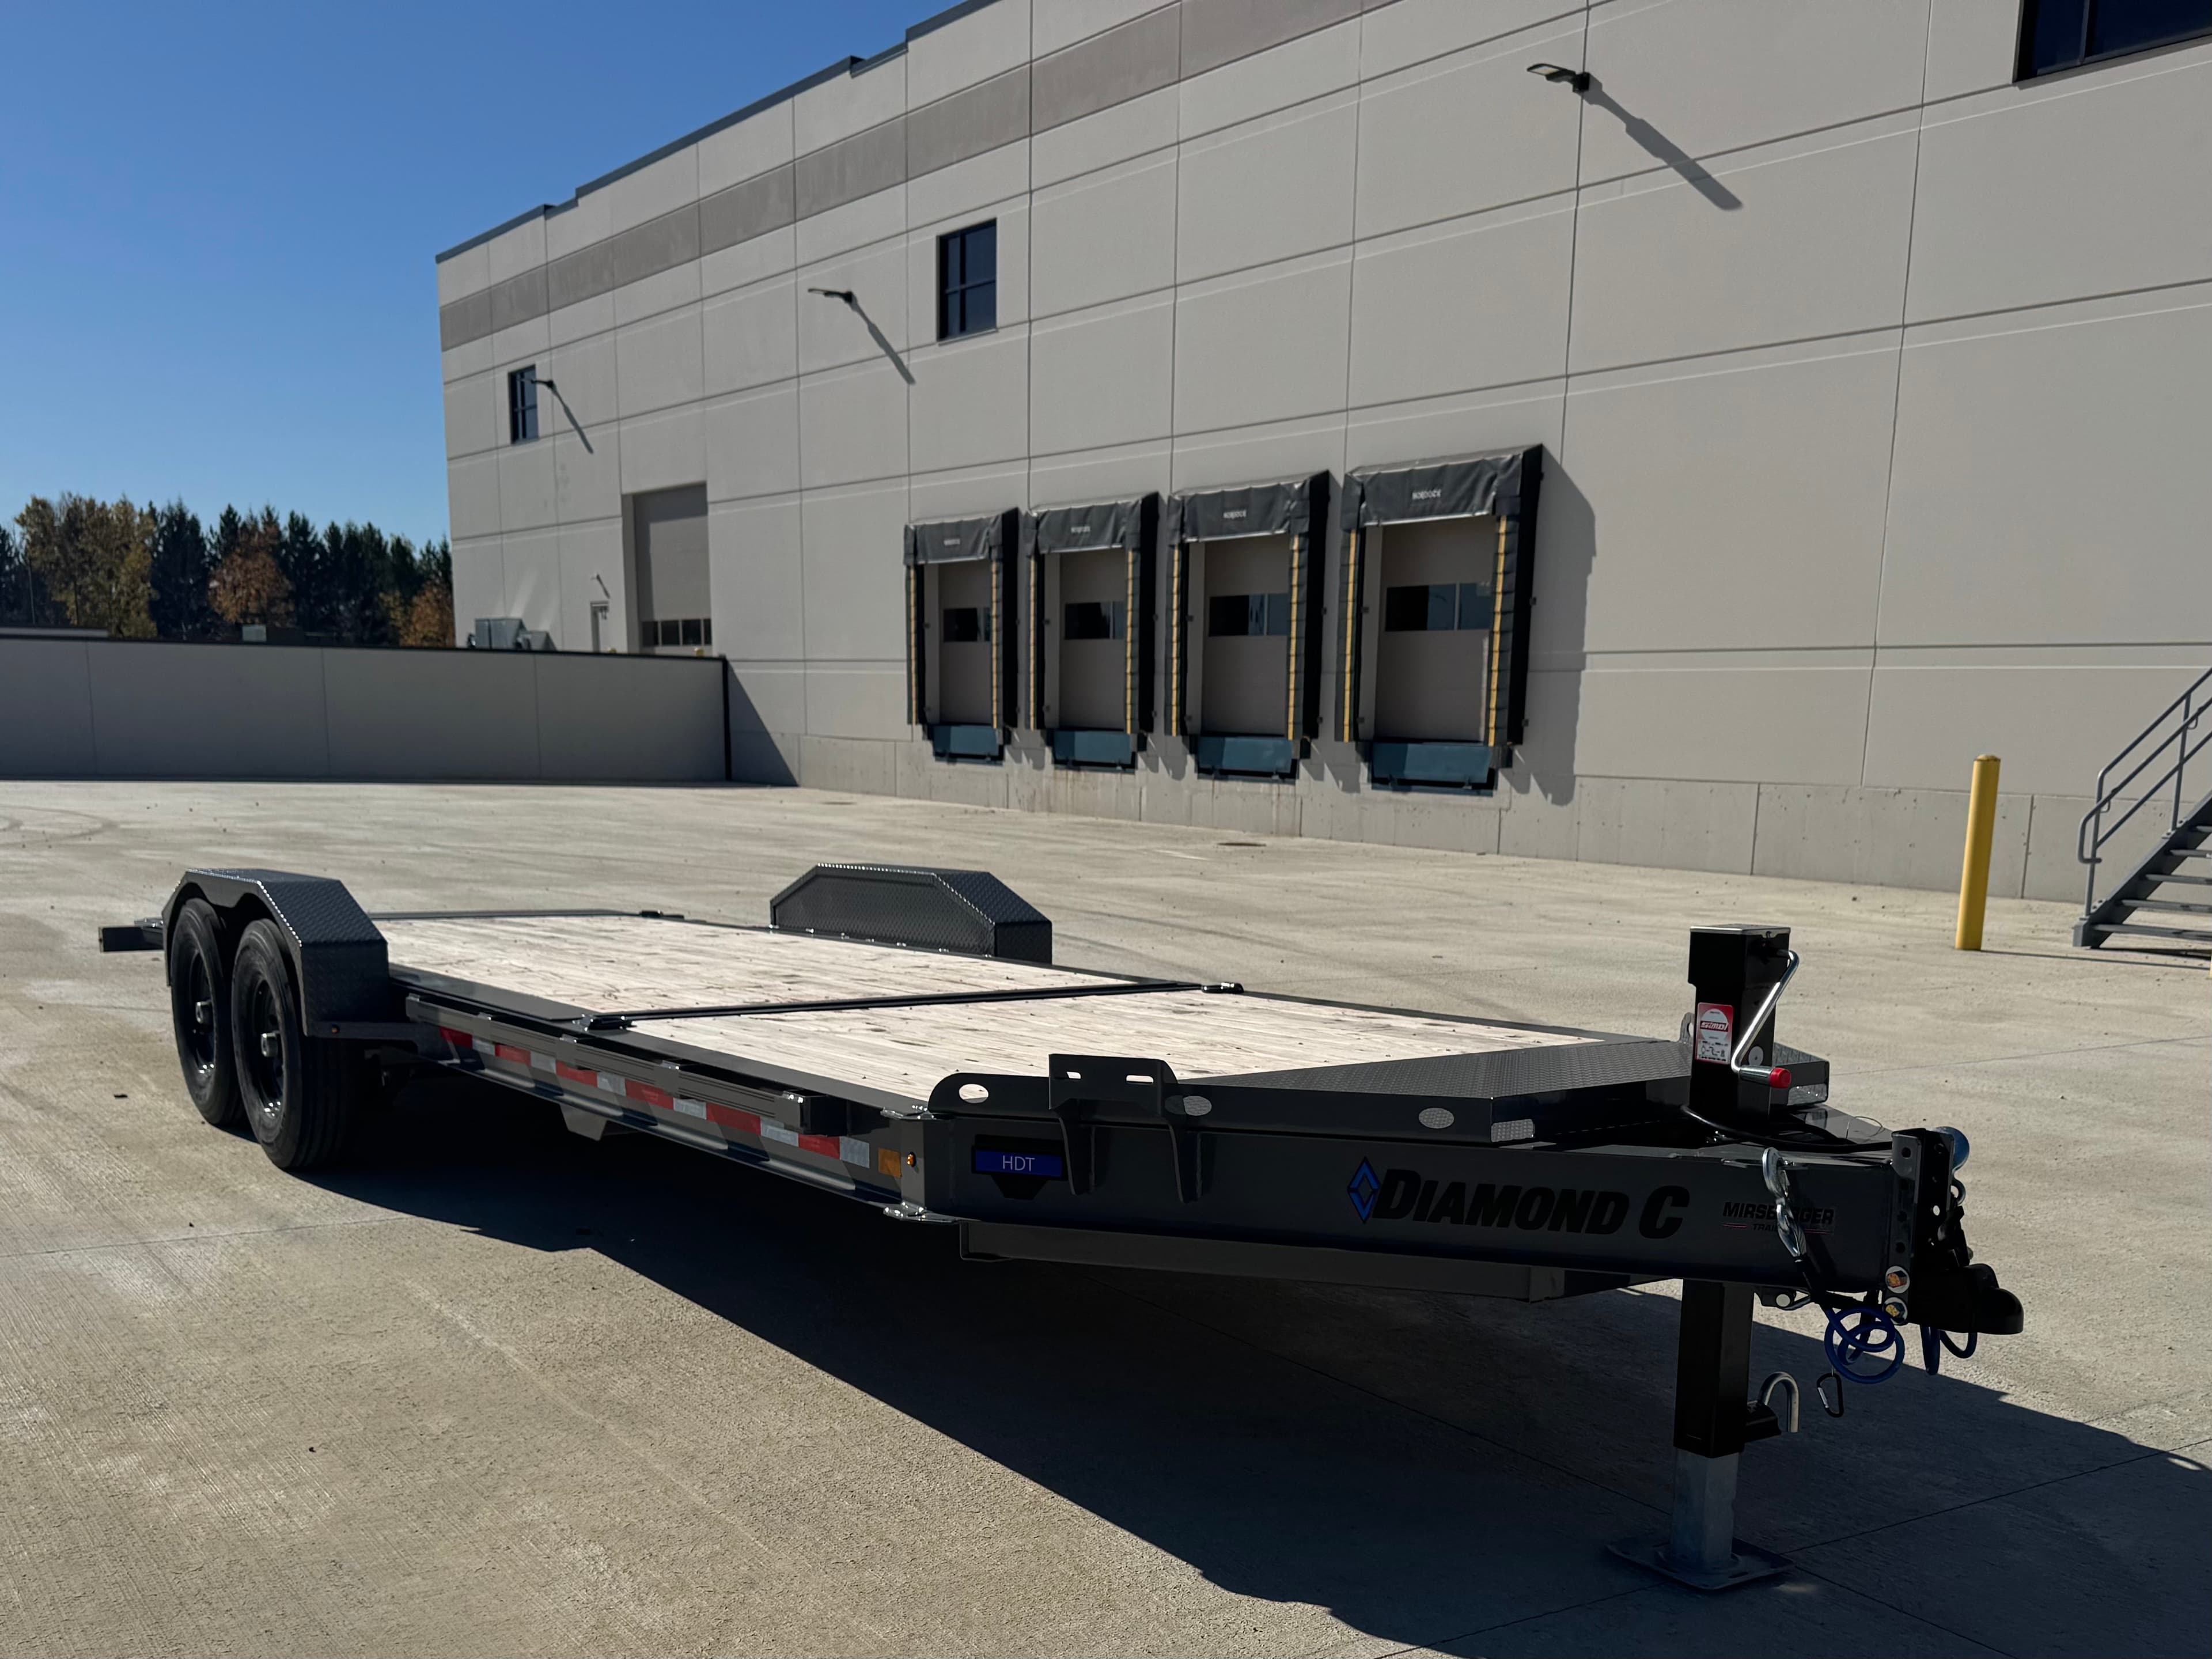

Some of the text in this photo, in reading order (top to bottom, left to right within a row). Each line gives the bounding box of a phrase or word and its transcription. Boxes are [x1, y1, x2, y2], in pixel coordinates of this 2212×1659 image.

[1002, 1154, 1036, 1172] HDT
[1372, 1169, 1690, 1239] DIAMOND C
[1723, 1201, 1834, 1224] MIRSBRGER
